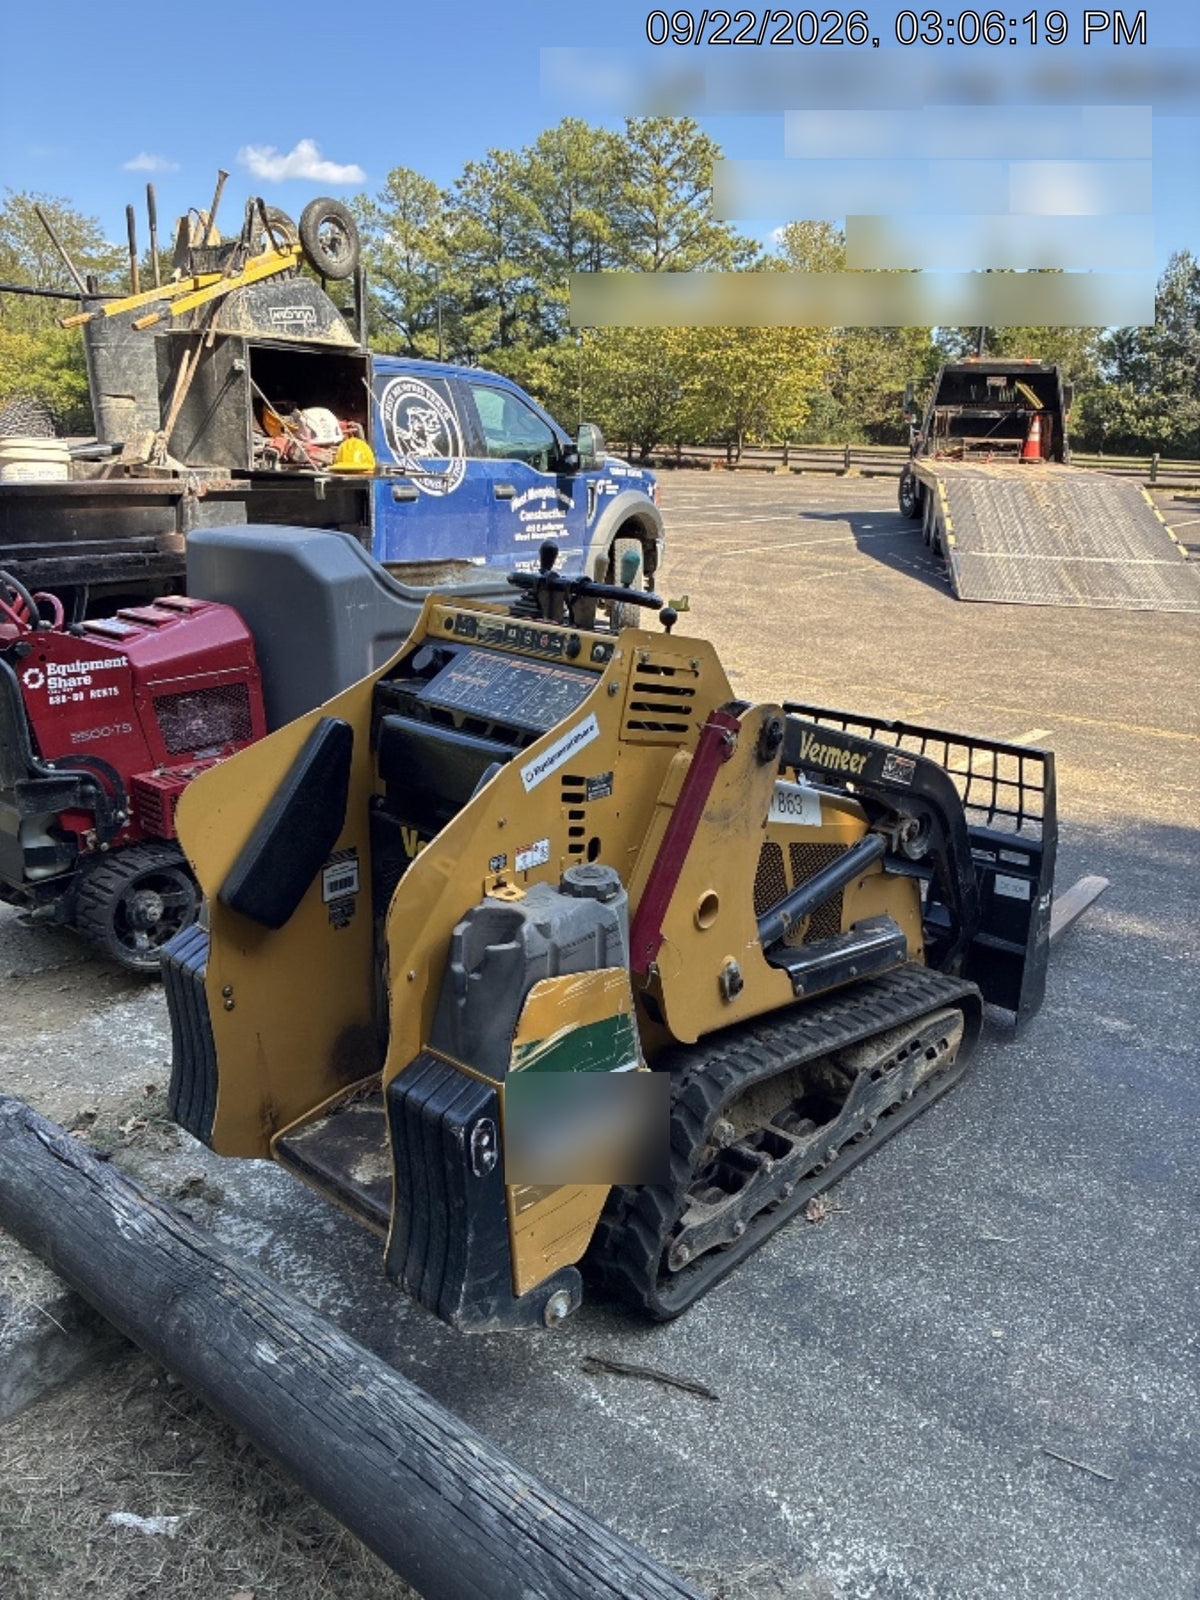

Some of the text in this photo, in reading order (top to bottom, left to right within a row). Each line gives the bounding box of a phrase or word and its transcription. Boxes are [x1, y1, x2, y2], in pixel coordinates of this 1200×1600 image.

[46, 656, 128, 676] Equipment
[47, 675, 93, 689] Share
[800, 730, 867, 775] Vermeer
[771, 790, 803, 815] 863
